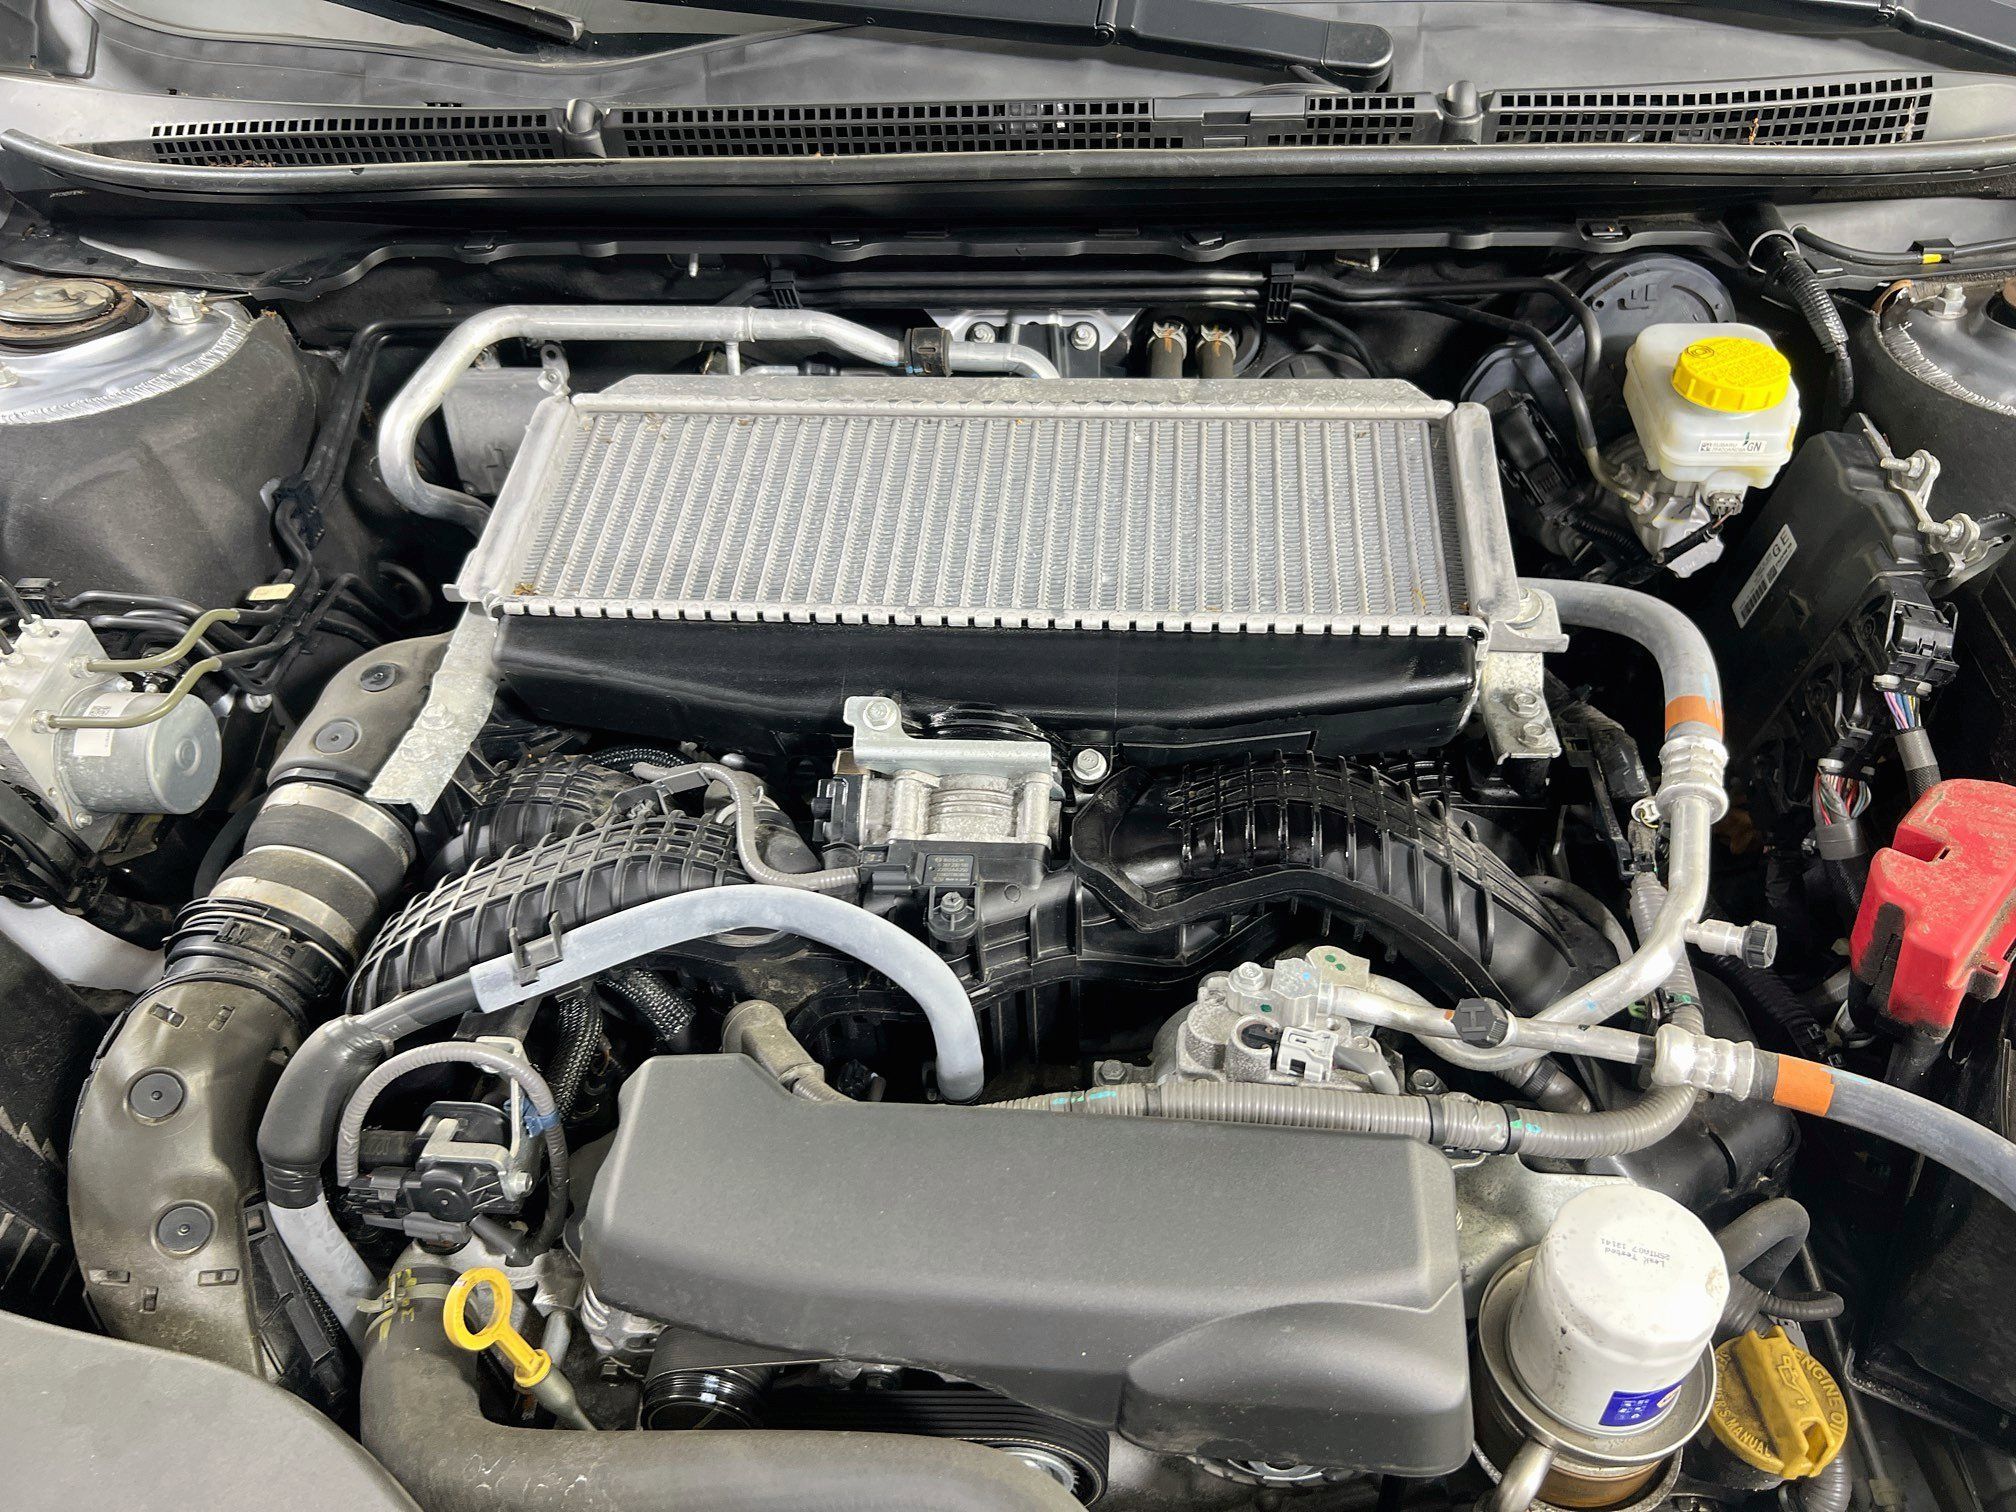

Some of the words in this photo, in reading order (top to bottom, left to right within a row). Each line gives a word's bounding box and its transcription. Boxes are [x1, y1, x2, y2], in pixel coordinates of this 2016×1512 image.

[1747, 442, 1762, 452] GN
[1604, 1247, 1638, 1260] Tested
[1643, 1256, 1665, 1267] Leak
[1792, 1347, 1840, 1406] ENGINE
[1726, 1418, 1772, 1458] MANUAL
